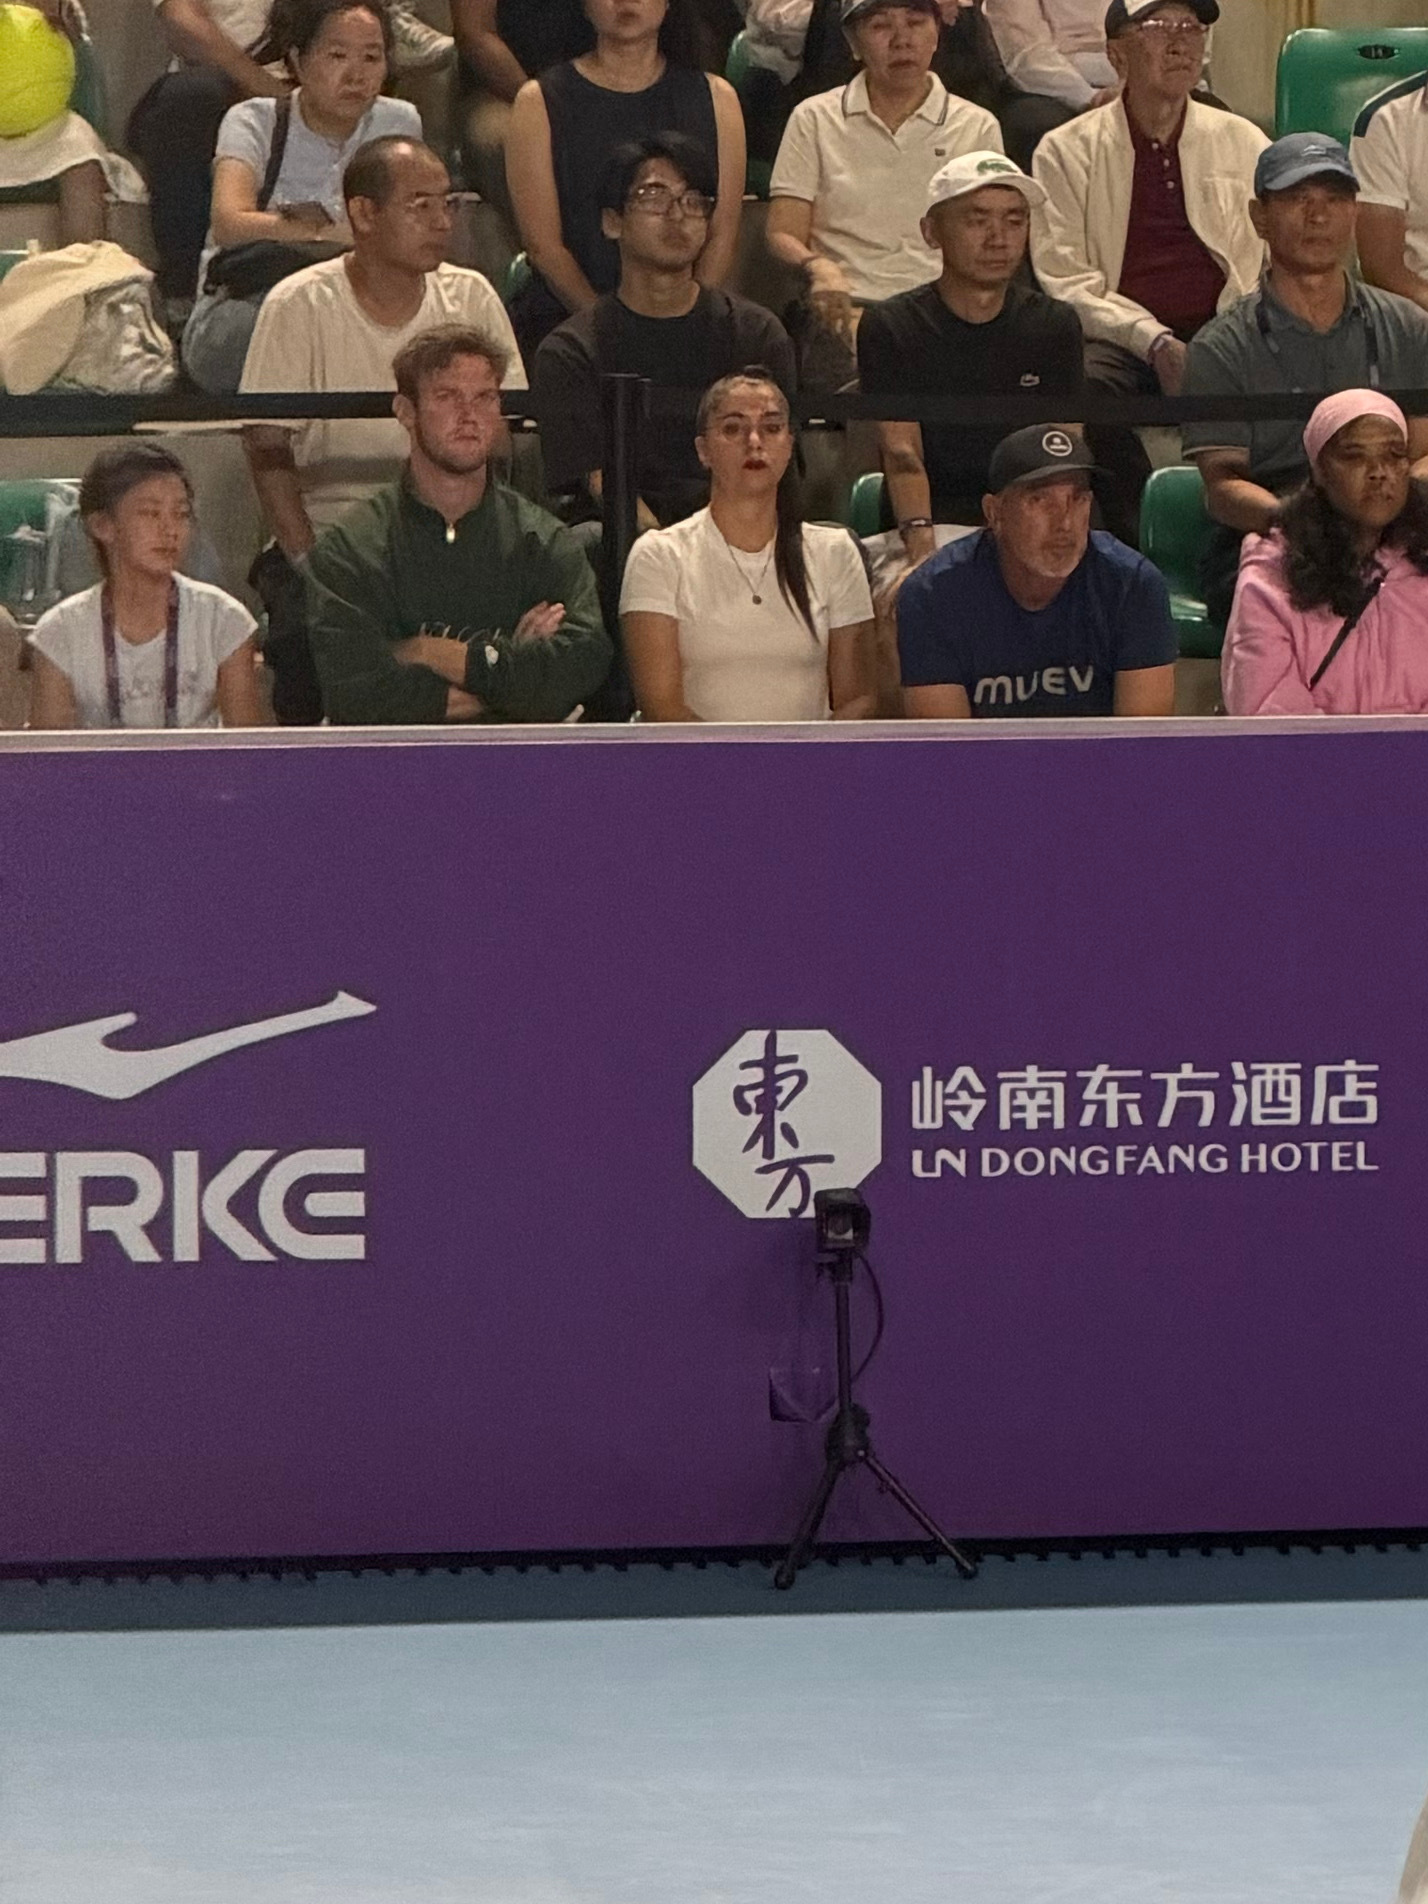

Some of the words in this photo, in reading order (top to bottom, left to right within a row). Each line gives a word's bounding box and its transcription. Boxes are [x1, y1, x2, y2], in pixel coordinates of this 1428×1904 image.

[911, 1059, 1380, 1131] 岭南东方酒店
[1240, 1140, 1380, 1173] HOTEL
[0, 1148, 366, 1264] ERKE
